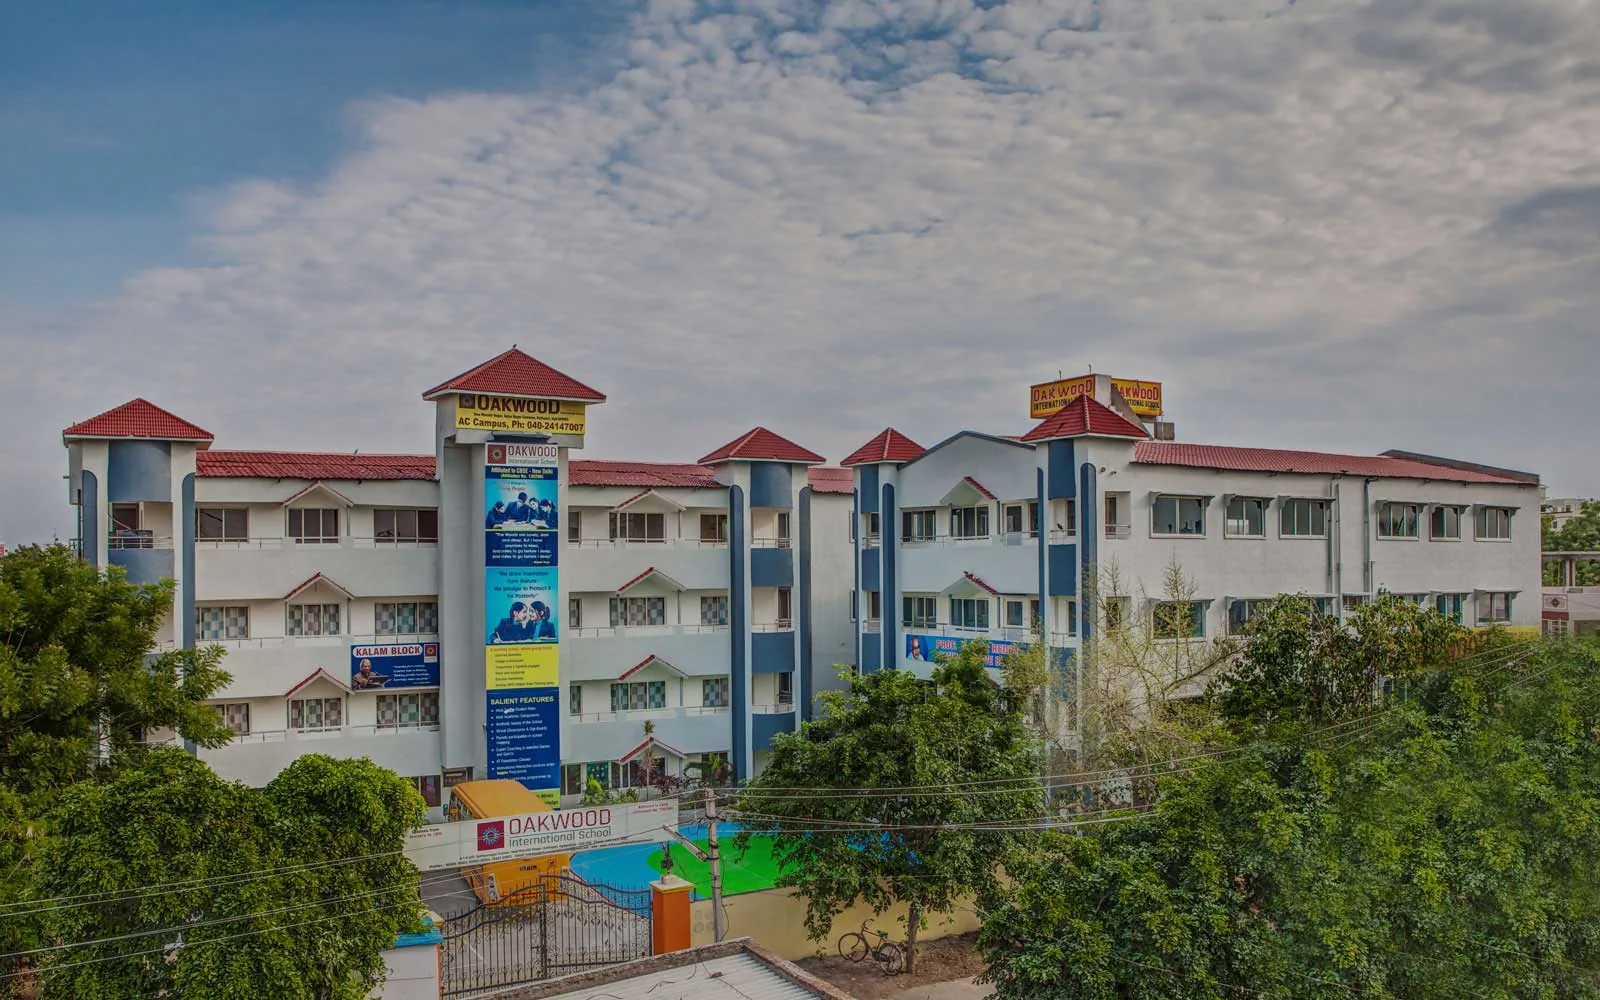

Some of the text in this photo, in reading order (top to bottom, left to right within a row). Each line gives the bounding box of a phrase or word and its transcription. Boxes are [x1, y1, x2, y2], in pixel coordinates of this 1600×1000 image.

[478, 394, 560, 414] OAKWOOD
[473, 418, 509, 429] Campus,
[527, 421, 584, 431] 040-24147007
[508, 446, 556, 456] OAKWOOD
[356, 646, 420, 656] KALAM BLOCK
[510, 809, 611, 835] OAKWOOD
[509, 832, 575, 848] International
[579, 827, 611, 840] School
